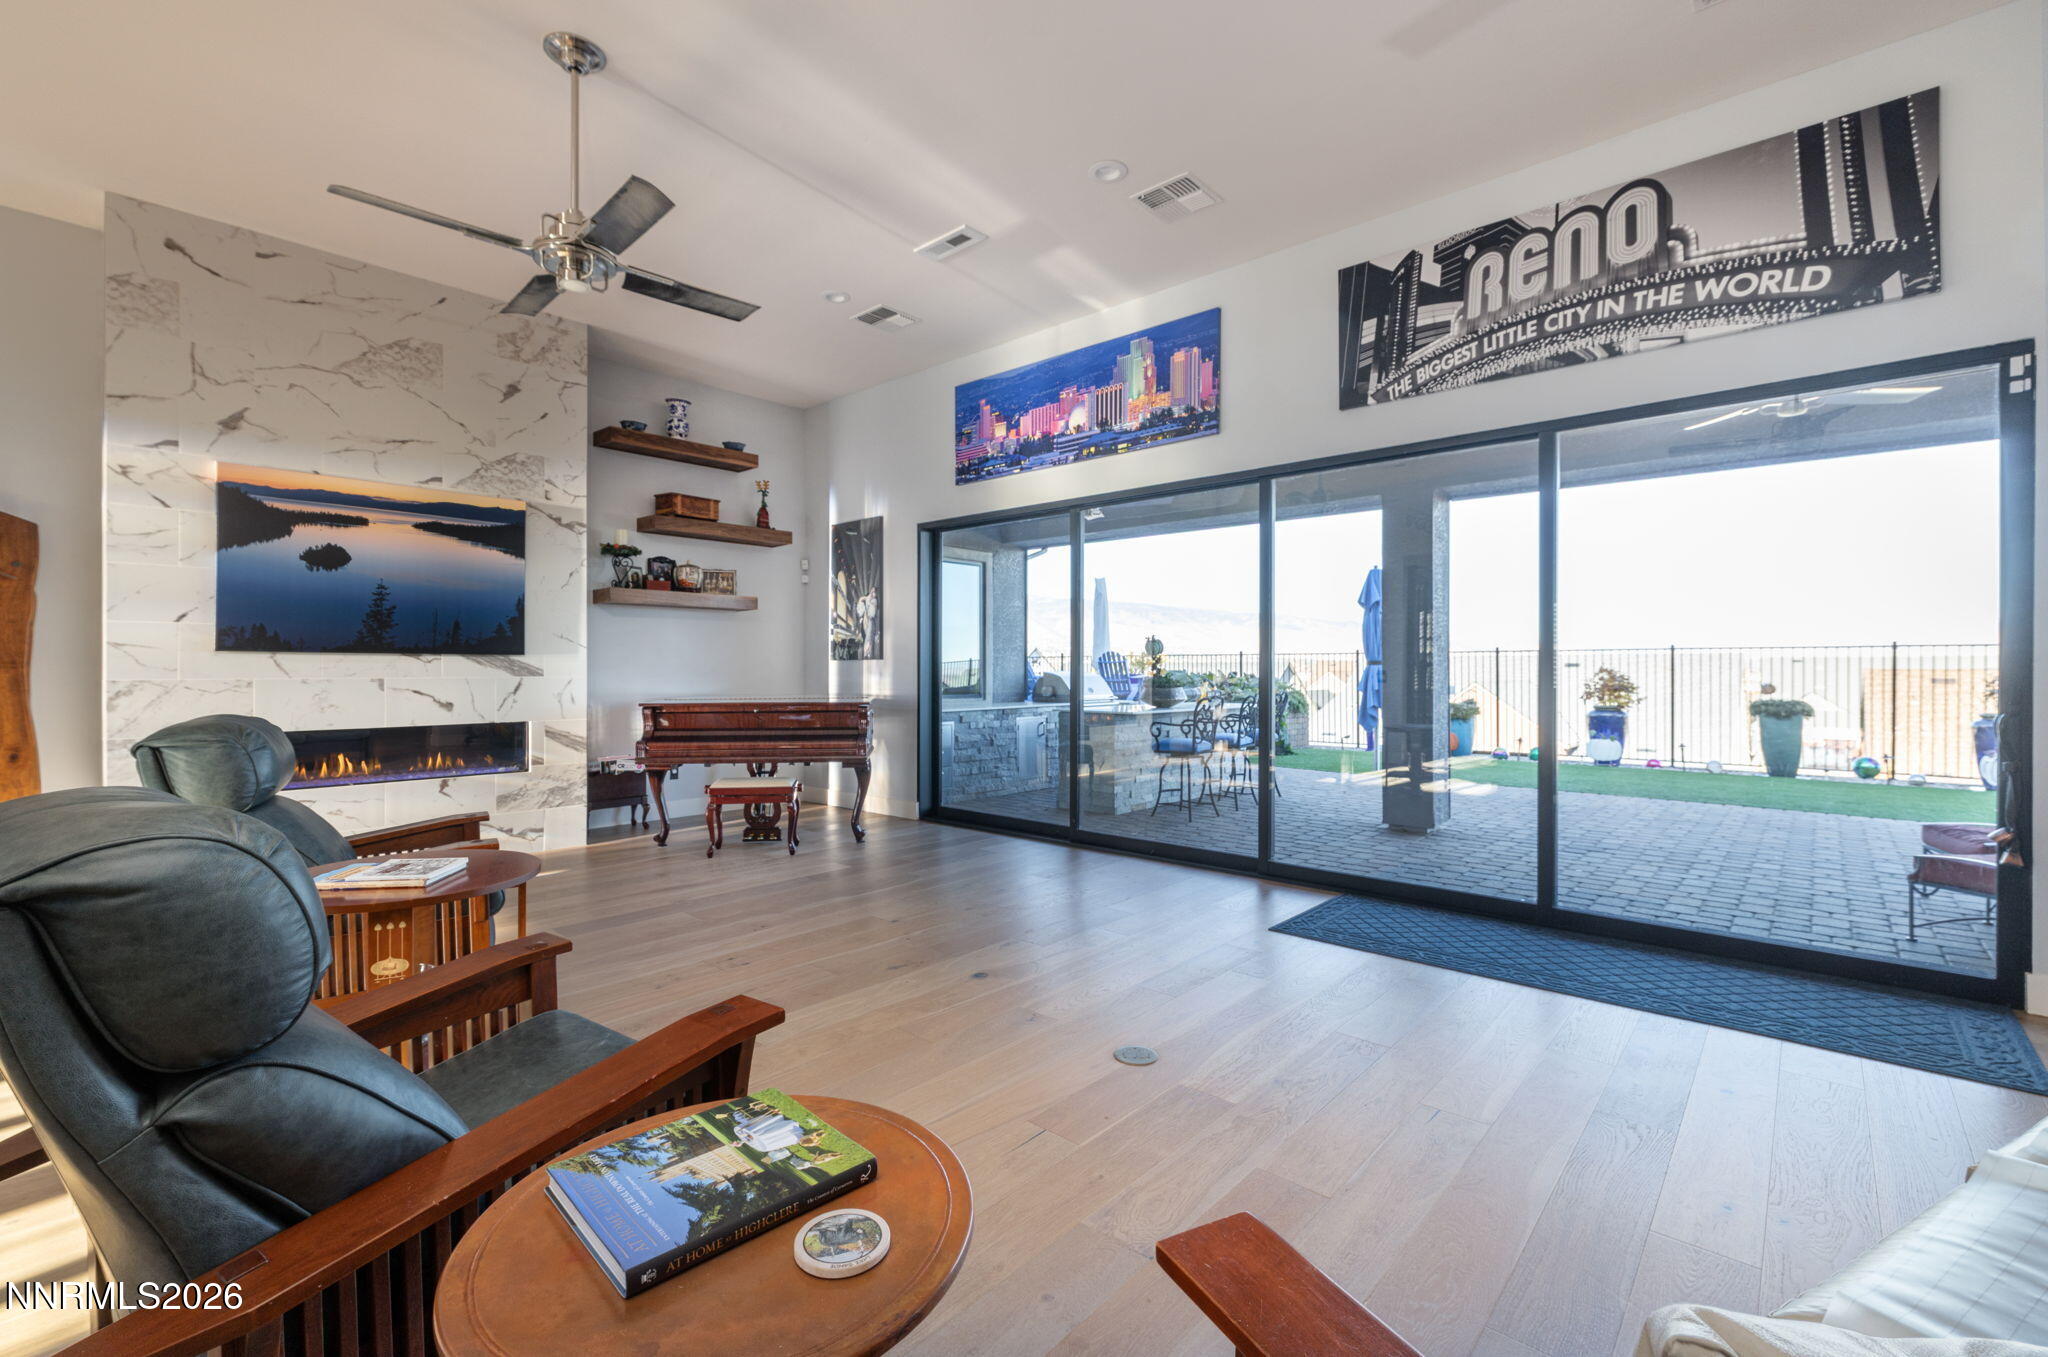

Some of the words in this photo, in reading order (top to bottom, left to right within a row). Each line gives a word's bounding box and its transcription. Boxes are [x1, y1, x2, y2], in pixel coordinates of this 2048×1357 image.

[1387, 377, 1414, 400] THE
[1416, 342, 1478, 383] BIGGEST
[1483, 319, 1538, 353] LITTLE
[1544, 303, 1592, 332] CITY
[1596, 296, 1625, 320] IN
[1633, 283, 1685, 311] THE
[1695, 265, 1832, 302] WORLD
[666, 1256, 685, 1272] AT
[686, 1238, 726, 1263] HOME
[734, 1202, 800, 1240] HIGHCLERE
